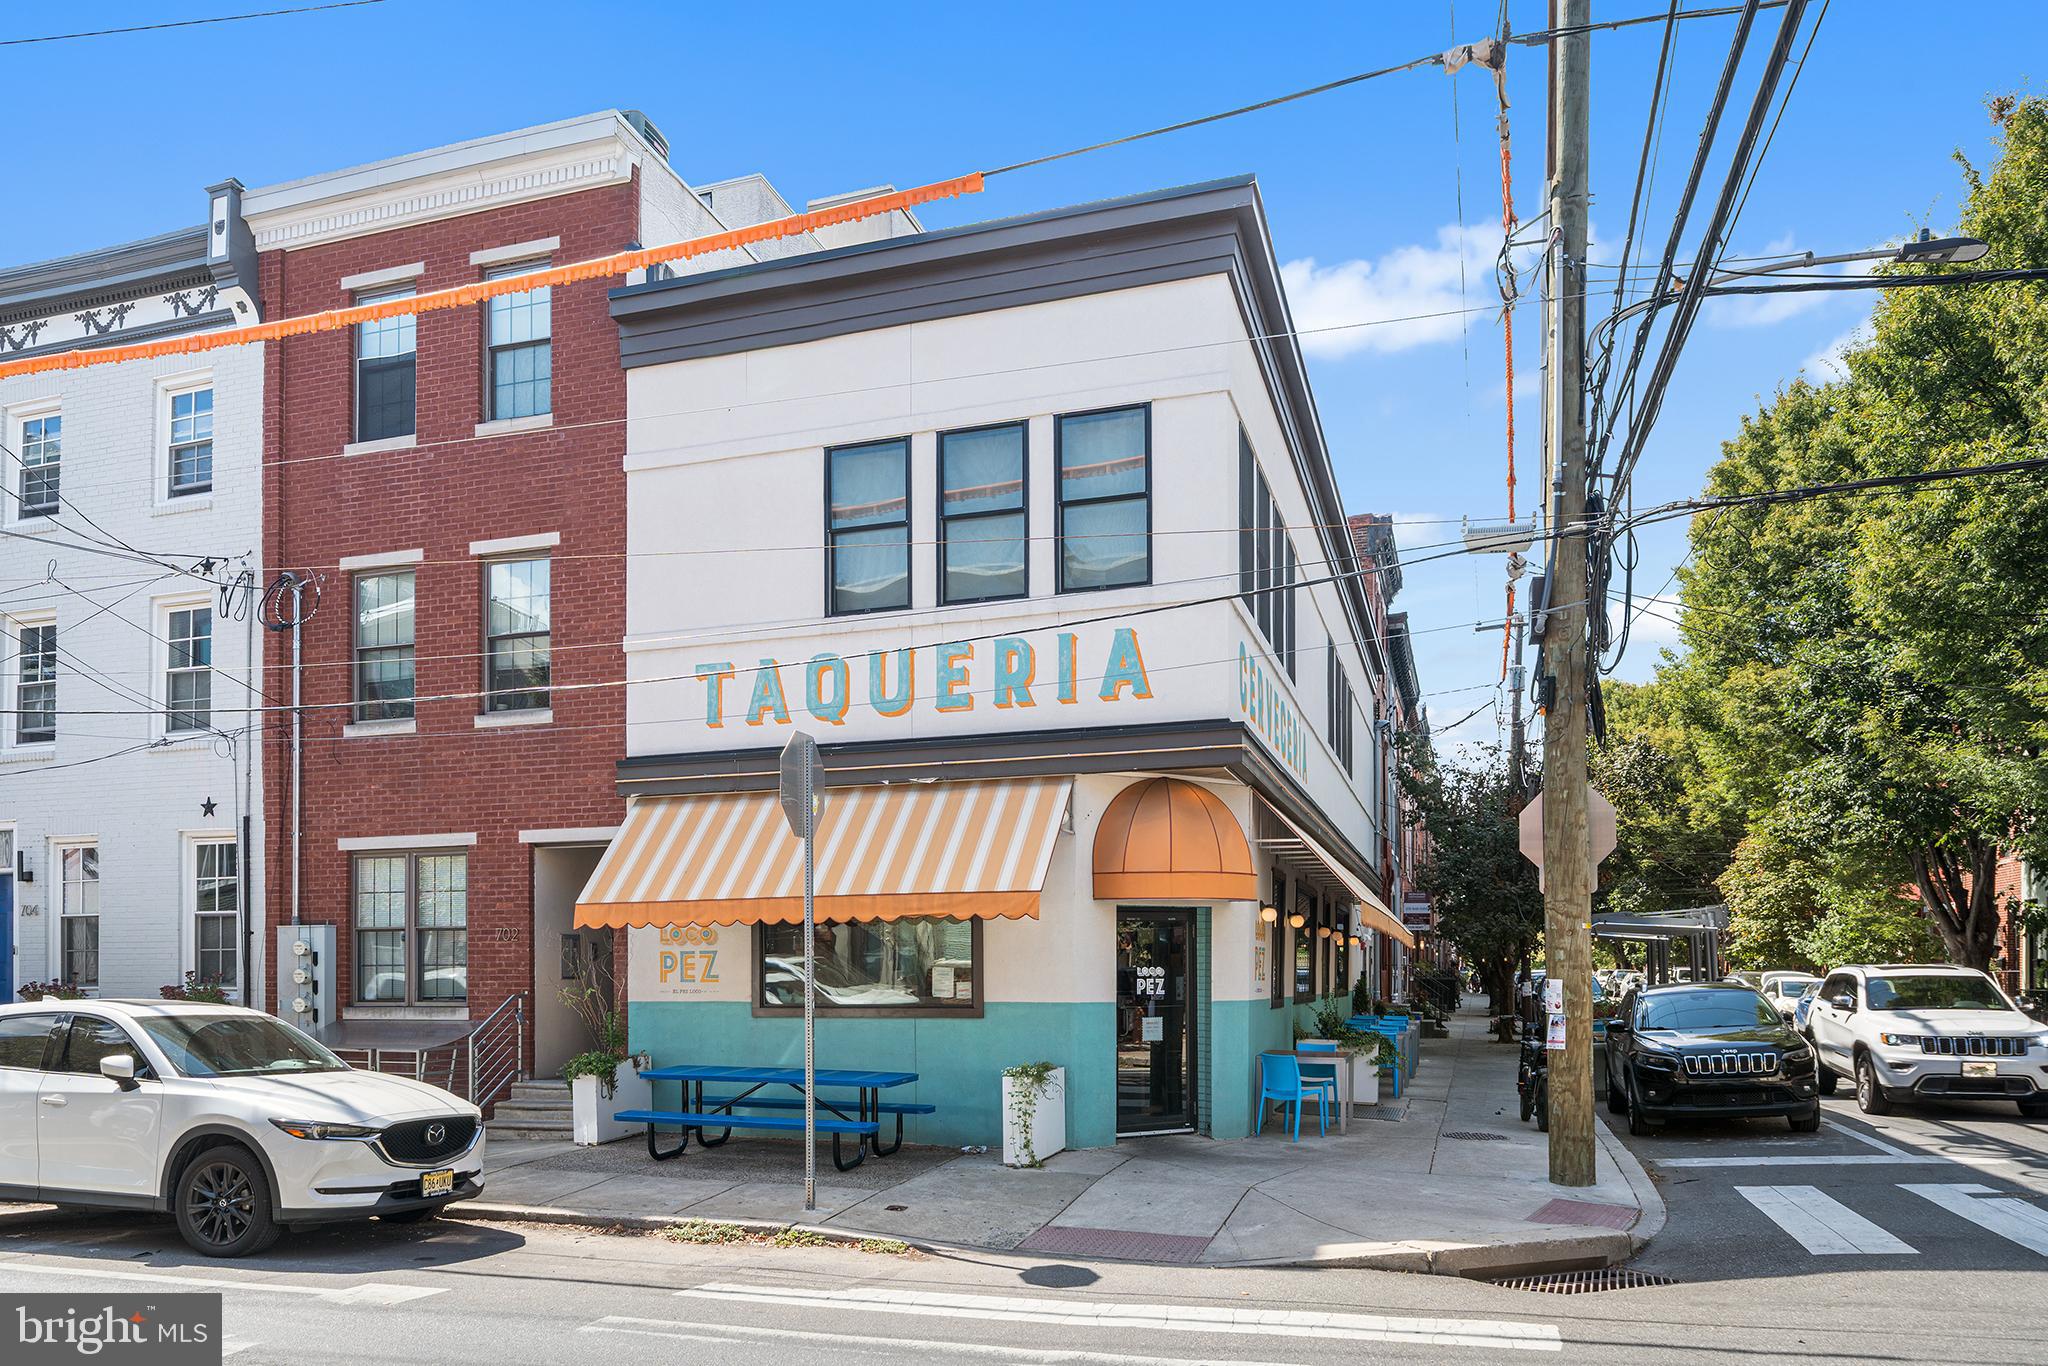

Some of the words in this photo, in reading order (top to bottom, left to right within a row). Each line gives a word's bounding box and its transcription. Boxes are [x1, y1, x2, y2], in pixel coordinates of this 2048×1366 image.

[695, 627, 1154, 729] TAQUERIA
[1239, 641, 1308, 784] CERVECERIA
[20, 904, 39, 917] 704
[496, 927, 519, 942] 702
[660, 927, 718, 946] LOCO
[659, 950, 720, 983] PEZ
[1136, 966, 1165, 977] LOCO
[1136, 978, 1166, 995] PEZ
